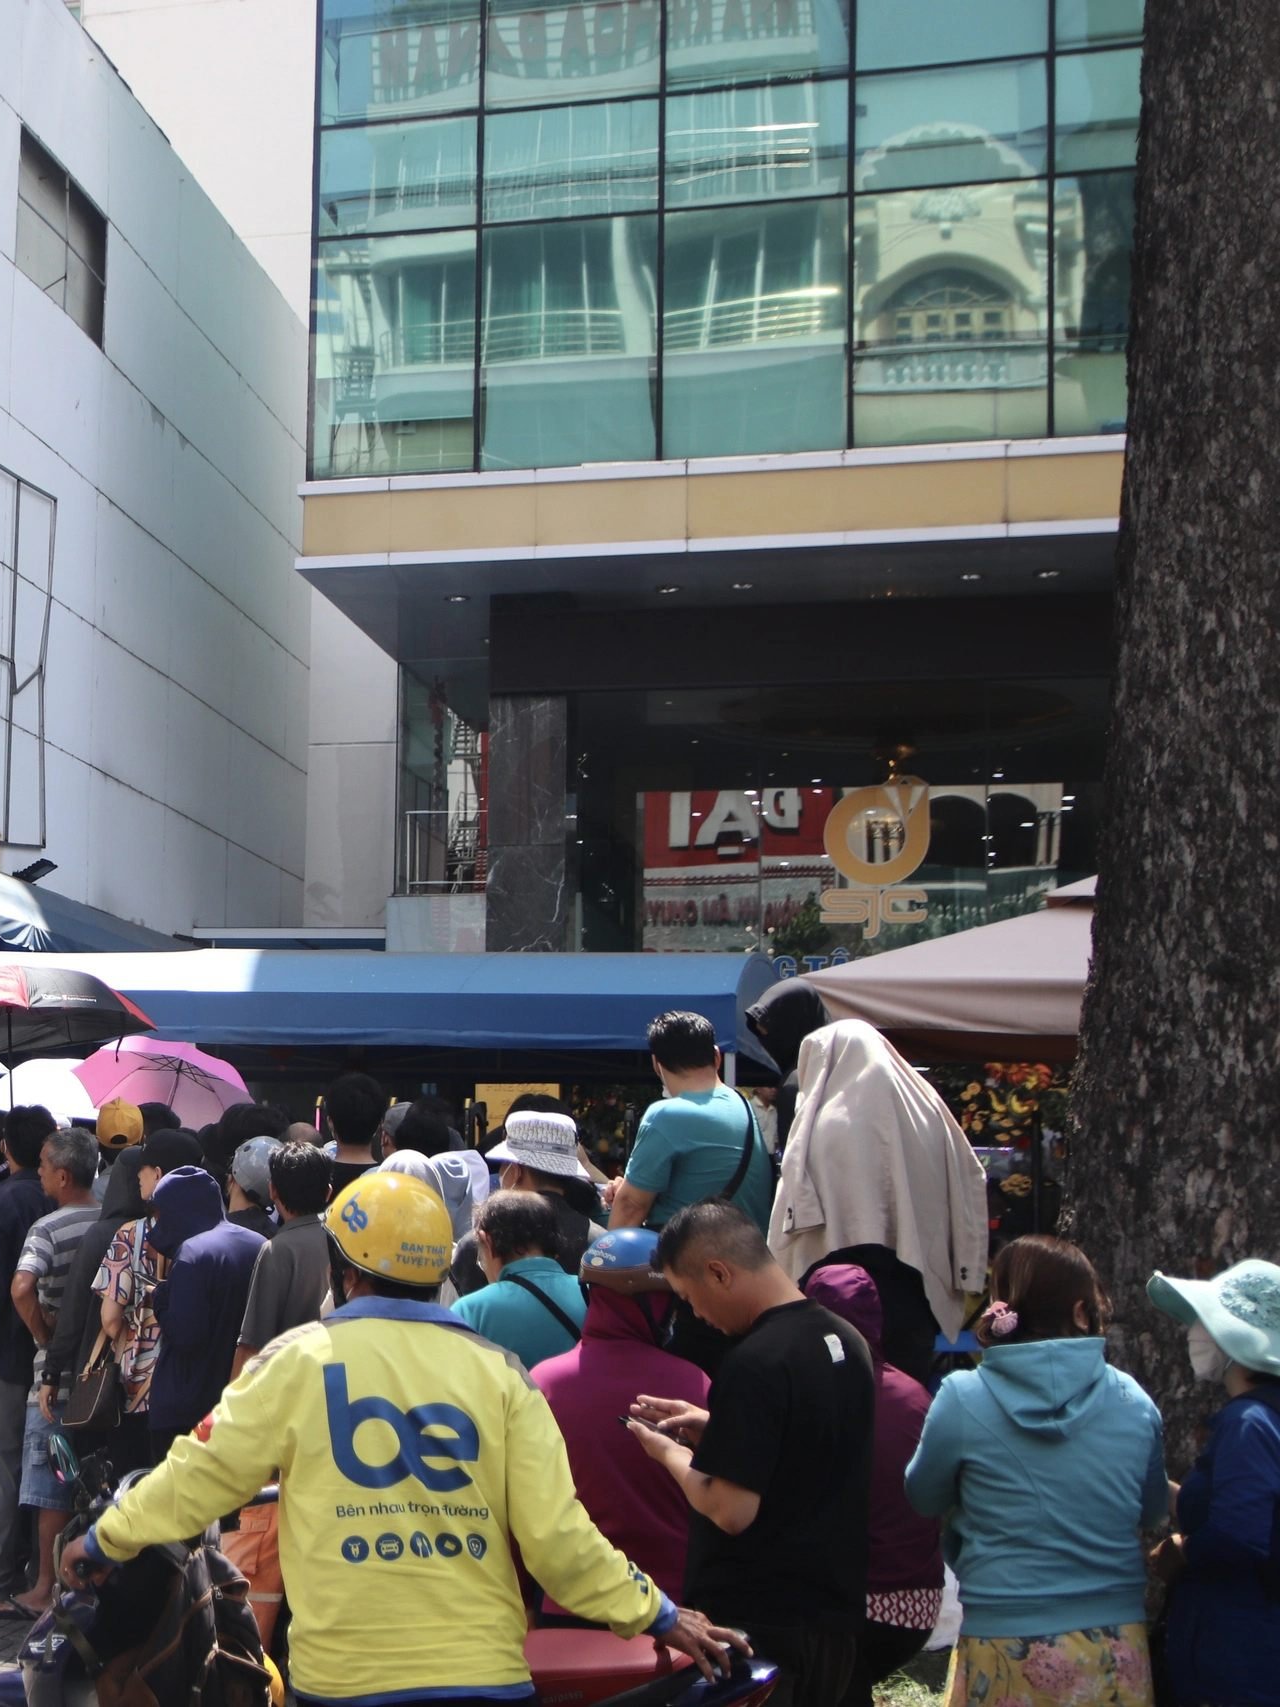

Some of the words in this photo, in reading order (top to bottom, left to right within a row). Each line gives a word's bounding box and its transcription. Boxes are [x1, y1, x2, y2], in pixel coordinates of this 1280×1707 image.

[819, 888, 928, 940] SJC
[341, 1191, 369, 1233] be
[322, 1362, 480, 1493] be
[335, 1503, 366, 1519] Bên
[369, 1501, 406, 1516] nhau
[407, 1501, 440, 1518] trọn
